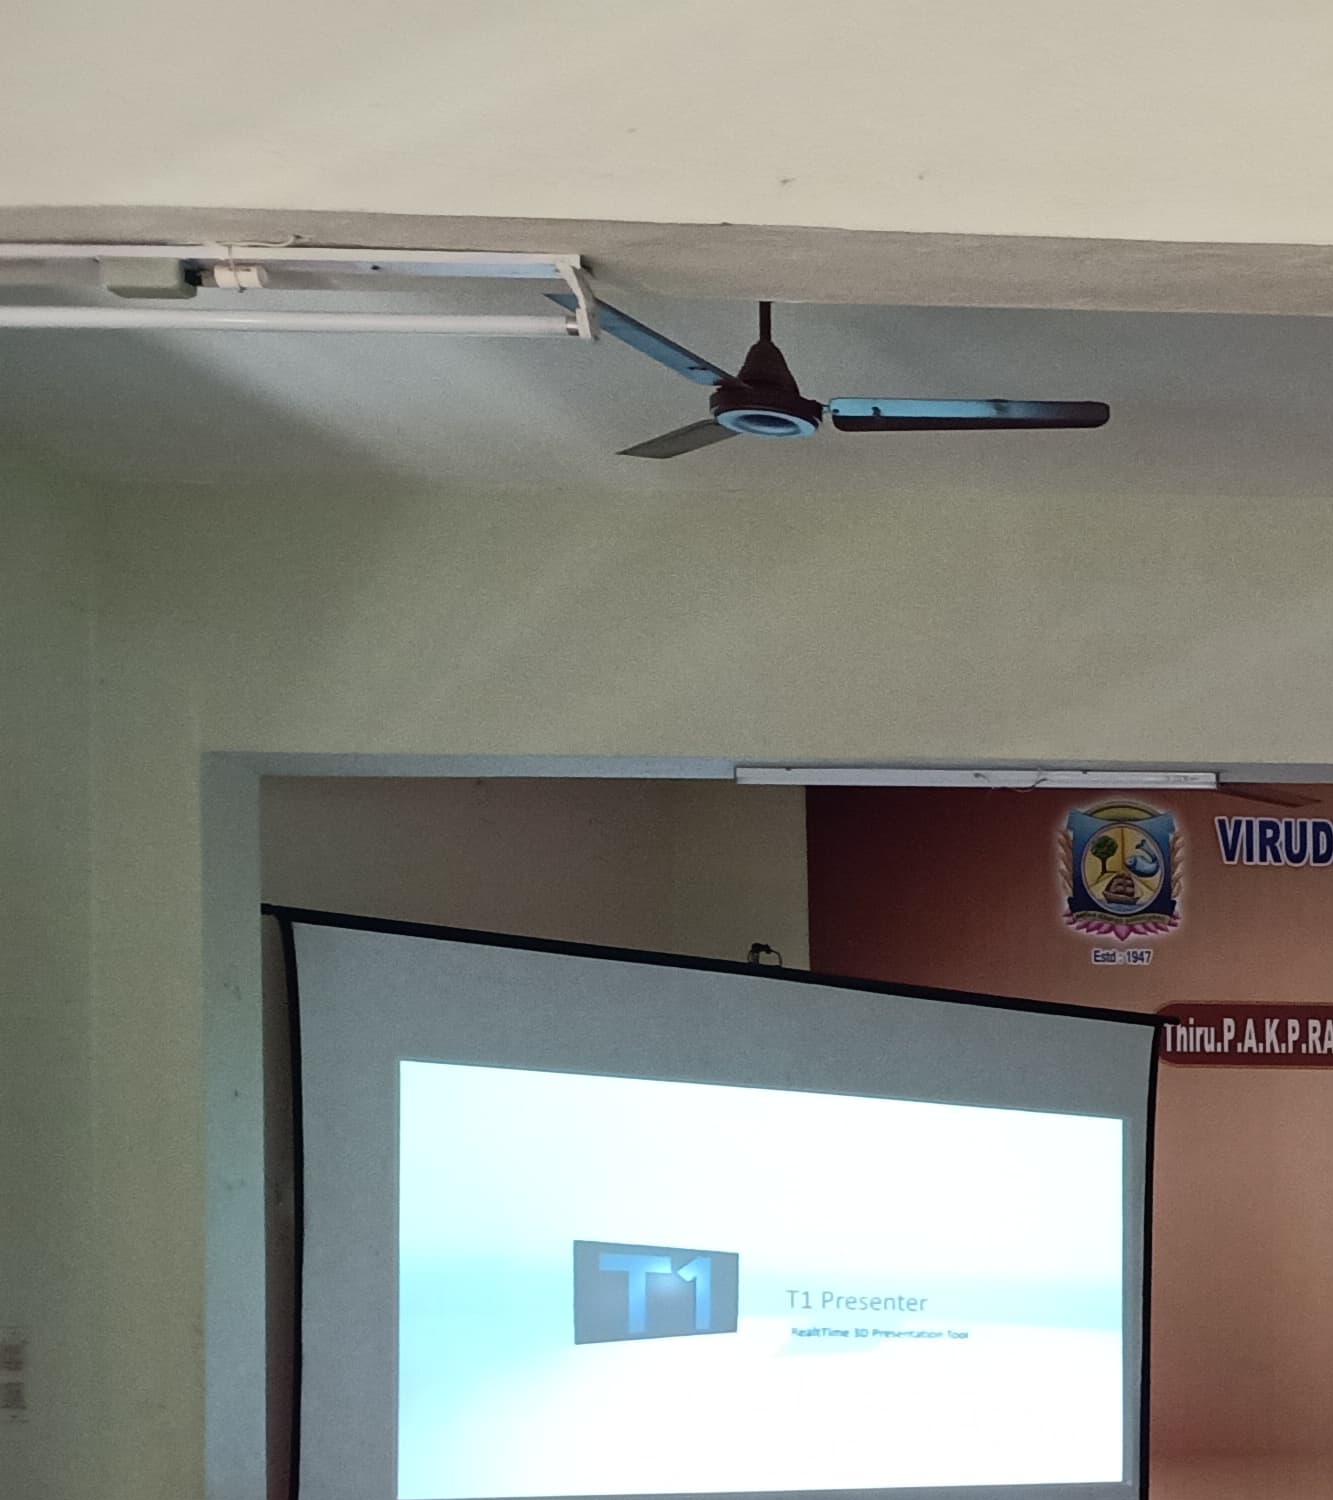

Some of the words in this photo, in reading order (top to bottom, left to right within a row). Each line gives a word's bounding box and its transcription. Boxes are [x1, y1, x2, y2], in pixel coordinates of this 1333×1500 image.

[1126, 950, 1152, 963] 1947
[599, 1252, 713, 1334] T1
[785, 1289, 813, 1310] T1
[821, 1290, 928, 1312] Presenter
